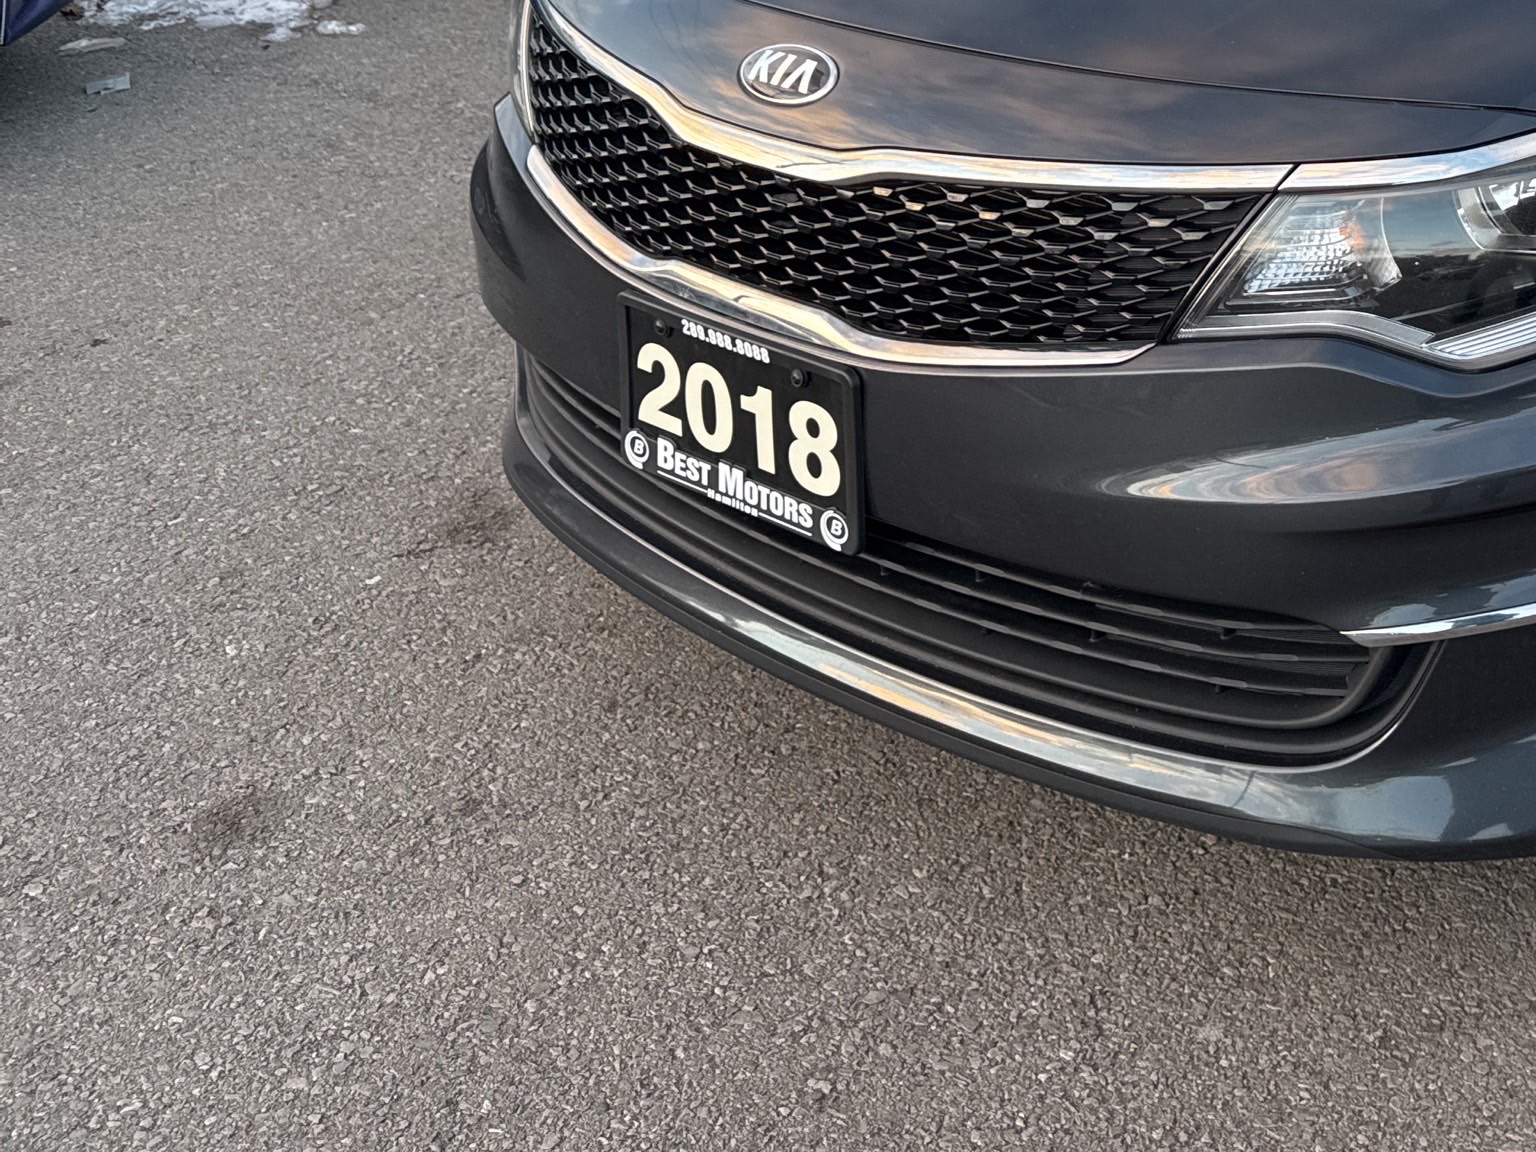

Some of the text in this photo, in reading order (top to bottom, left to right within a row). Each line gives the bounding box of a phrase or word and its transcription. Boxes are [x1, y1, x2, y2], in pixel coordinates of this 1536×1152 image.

[747, 49, 818, 94] KIA
[637, 342, 841, 497] 2018
[657, 434, 813, 529] BEST MOTORS
